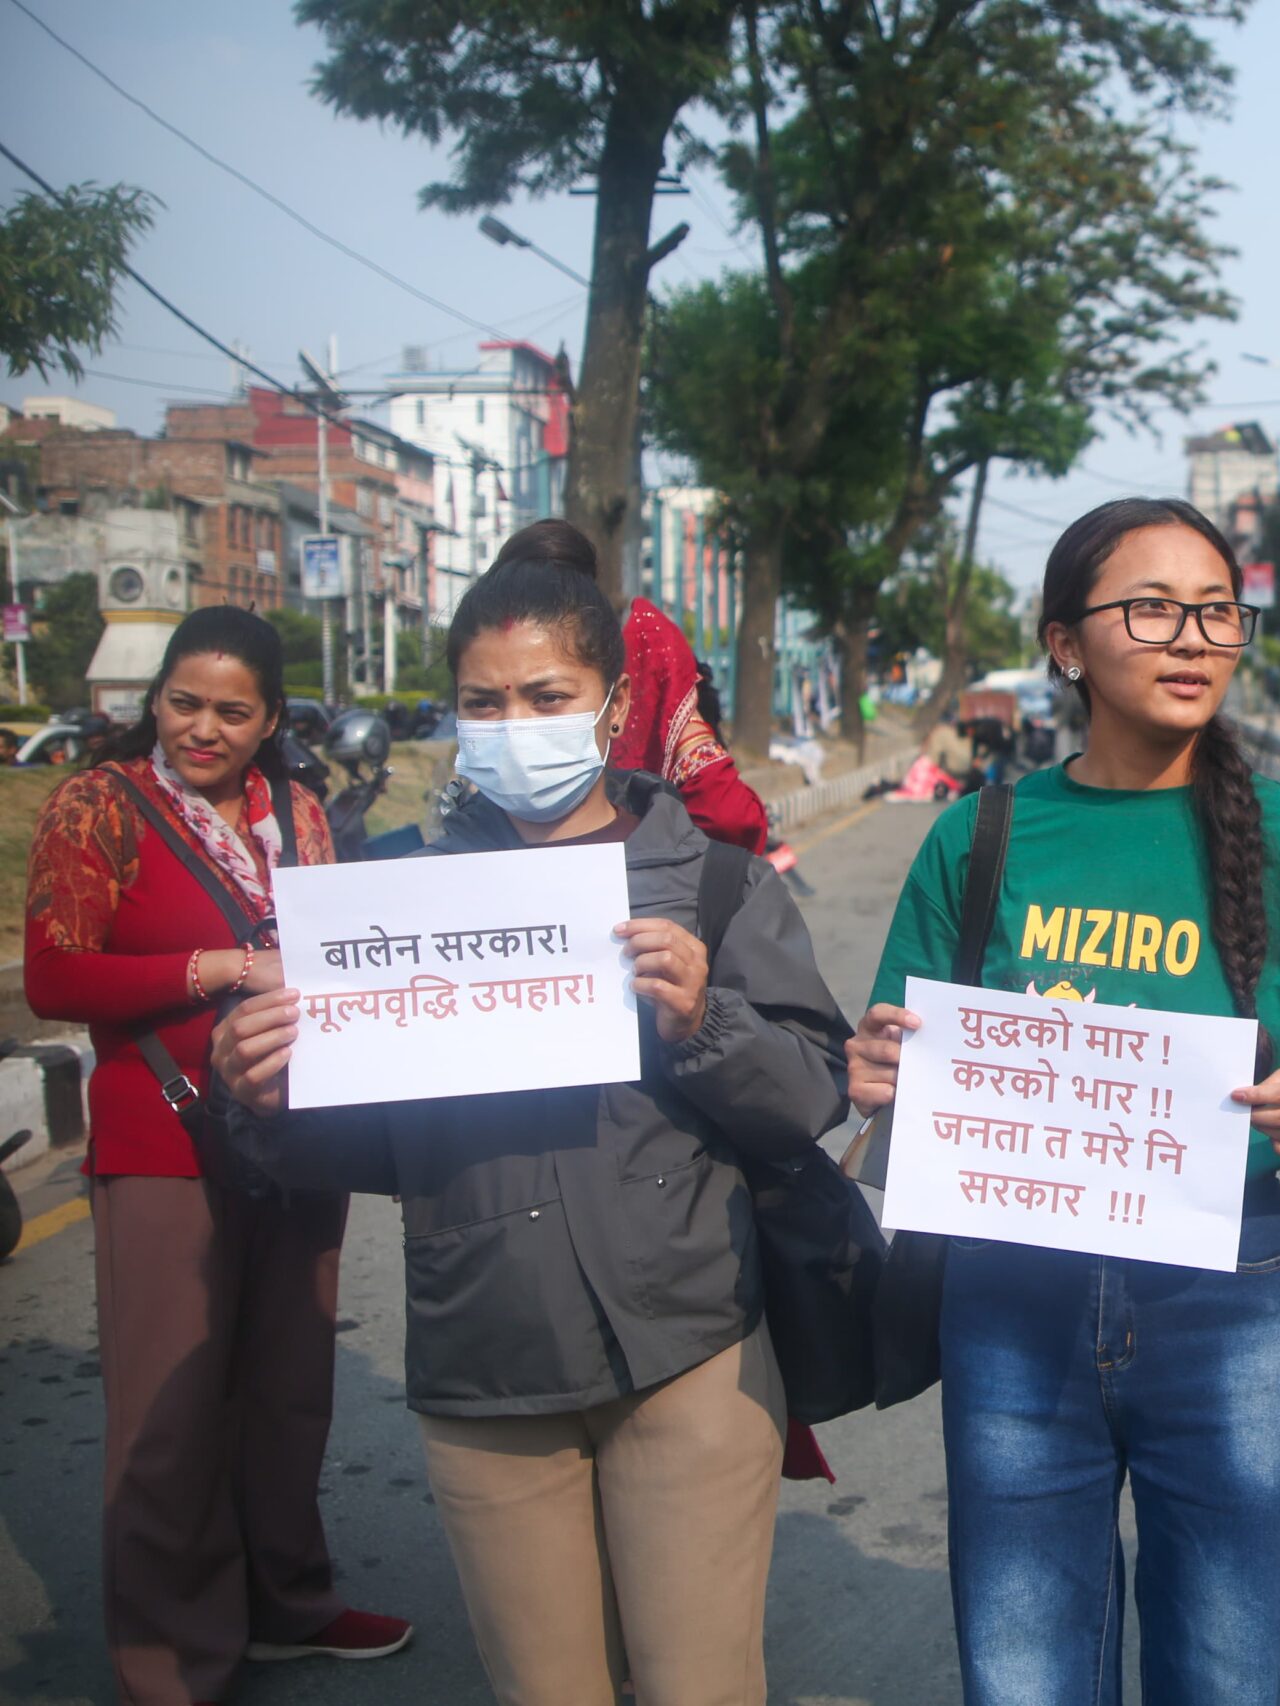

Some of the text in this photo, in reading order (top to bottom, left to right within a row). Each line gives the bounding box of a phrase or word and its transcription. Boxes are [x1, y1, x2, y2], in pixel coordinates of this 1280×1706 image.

[321, 924, 569, 969] बालेन सरकार!
[1020, 904, 1200, 976] MIZIRO
[304, 974, 595, 1032] मूल्यवृद्धि उपहार!
[958, 1007, 1171, 1065] युद्धको मार !
[951, 1058, 1173, 1119] करको भार !!
[932, 1111, 1187, 1175] जनता त मरे नि
[958, 1170, 1146, 1225] सरकार !!!
